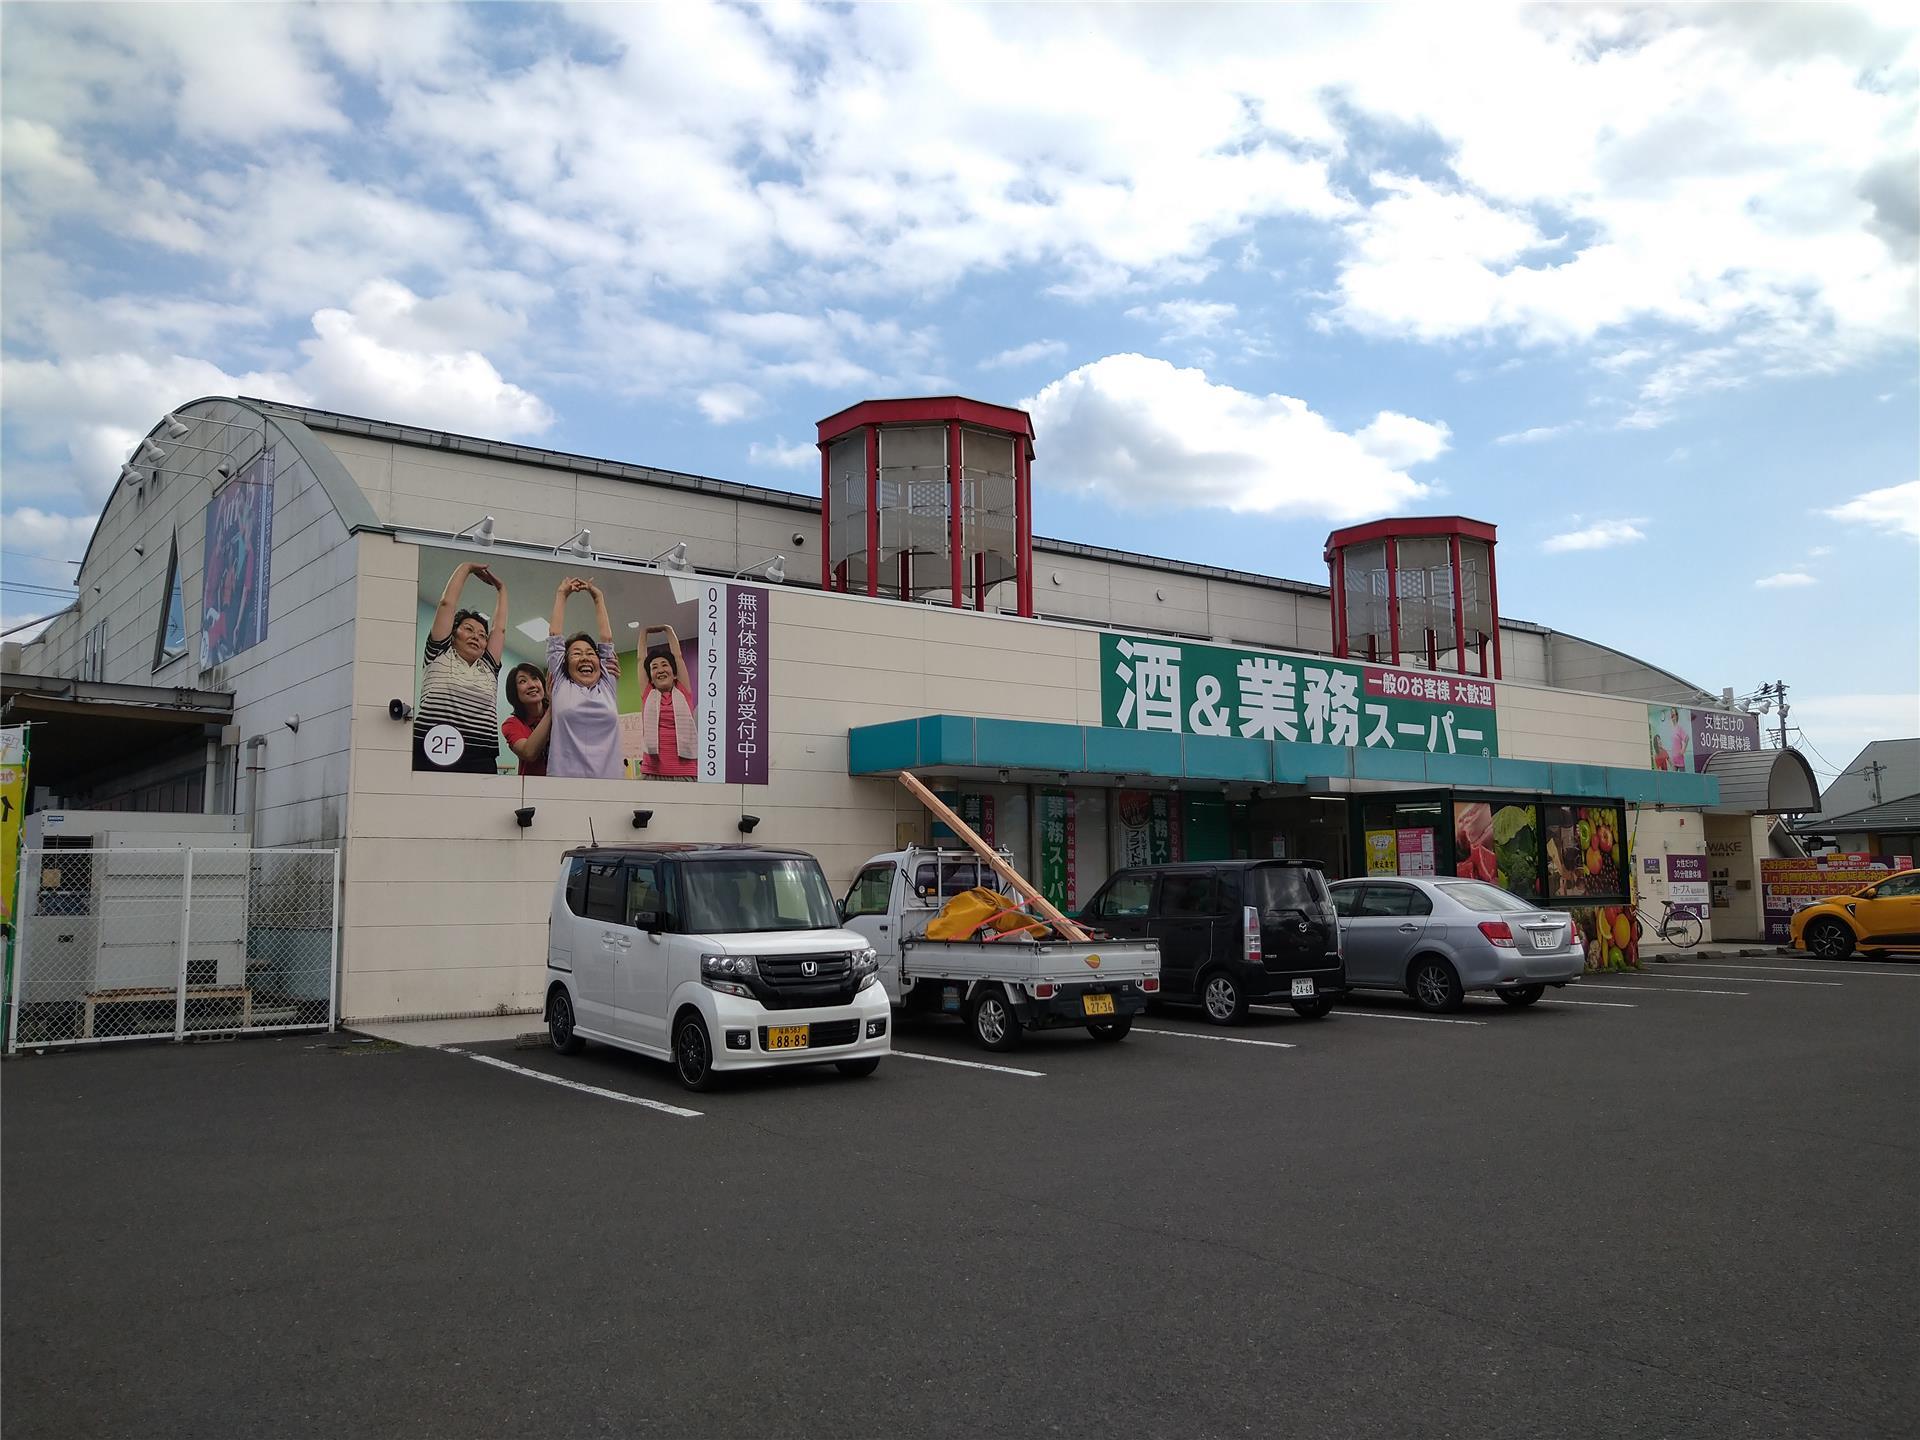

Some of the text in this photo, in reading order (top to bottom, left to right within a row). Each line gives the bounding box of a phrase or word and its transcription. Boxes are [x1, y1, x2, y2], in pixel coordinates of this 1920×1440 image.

[707, 587, 718, 776] 024-573-5553
[737, 592, 757, 776] 無料体験予約受付中!
[1368, 672, 1492, 706] 一般のお客様 大歓迎
[1704, 713, 1744, 732] 女性だけの
[431, 735, 457, 754] 2F
[1700, 732, 1751, 751] 30分健康体操
[1296, 984, 1313, 994] 24-68
[1090, 1001, 1113, 1013] 27-36
[776, 1034, 807, 1048] 88-89
